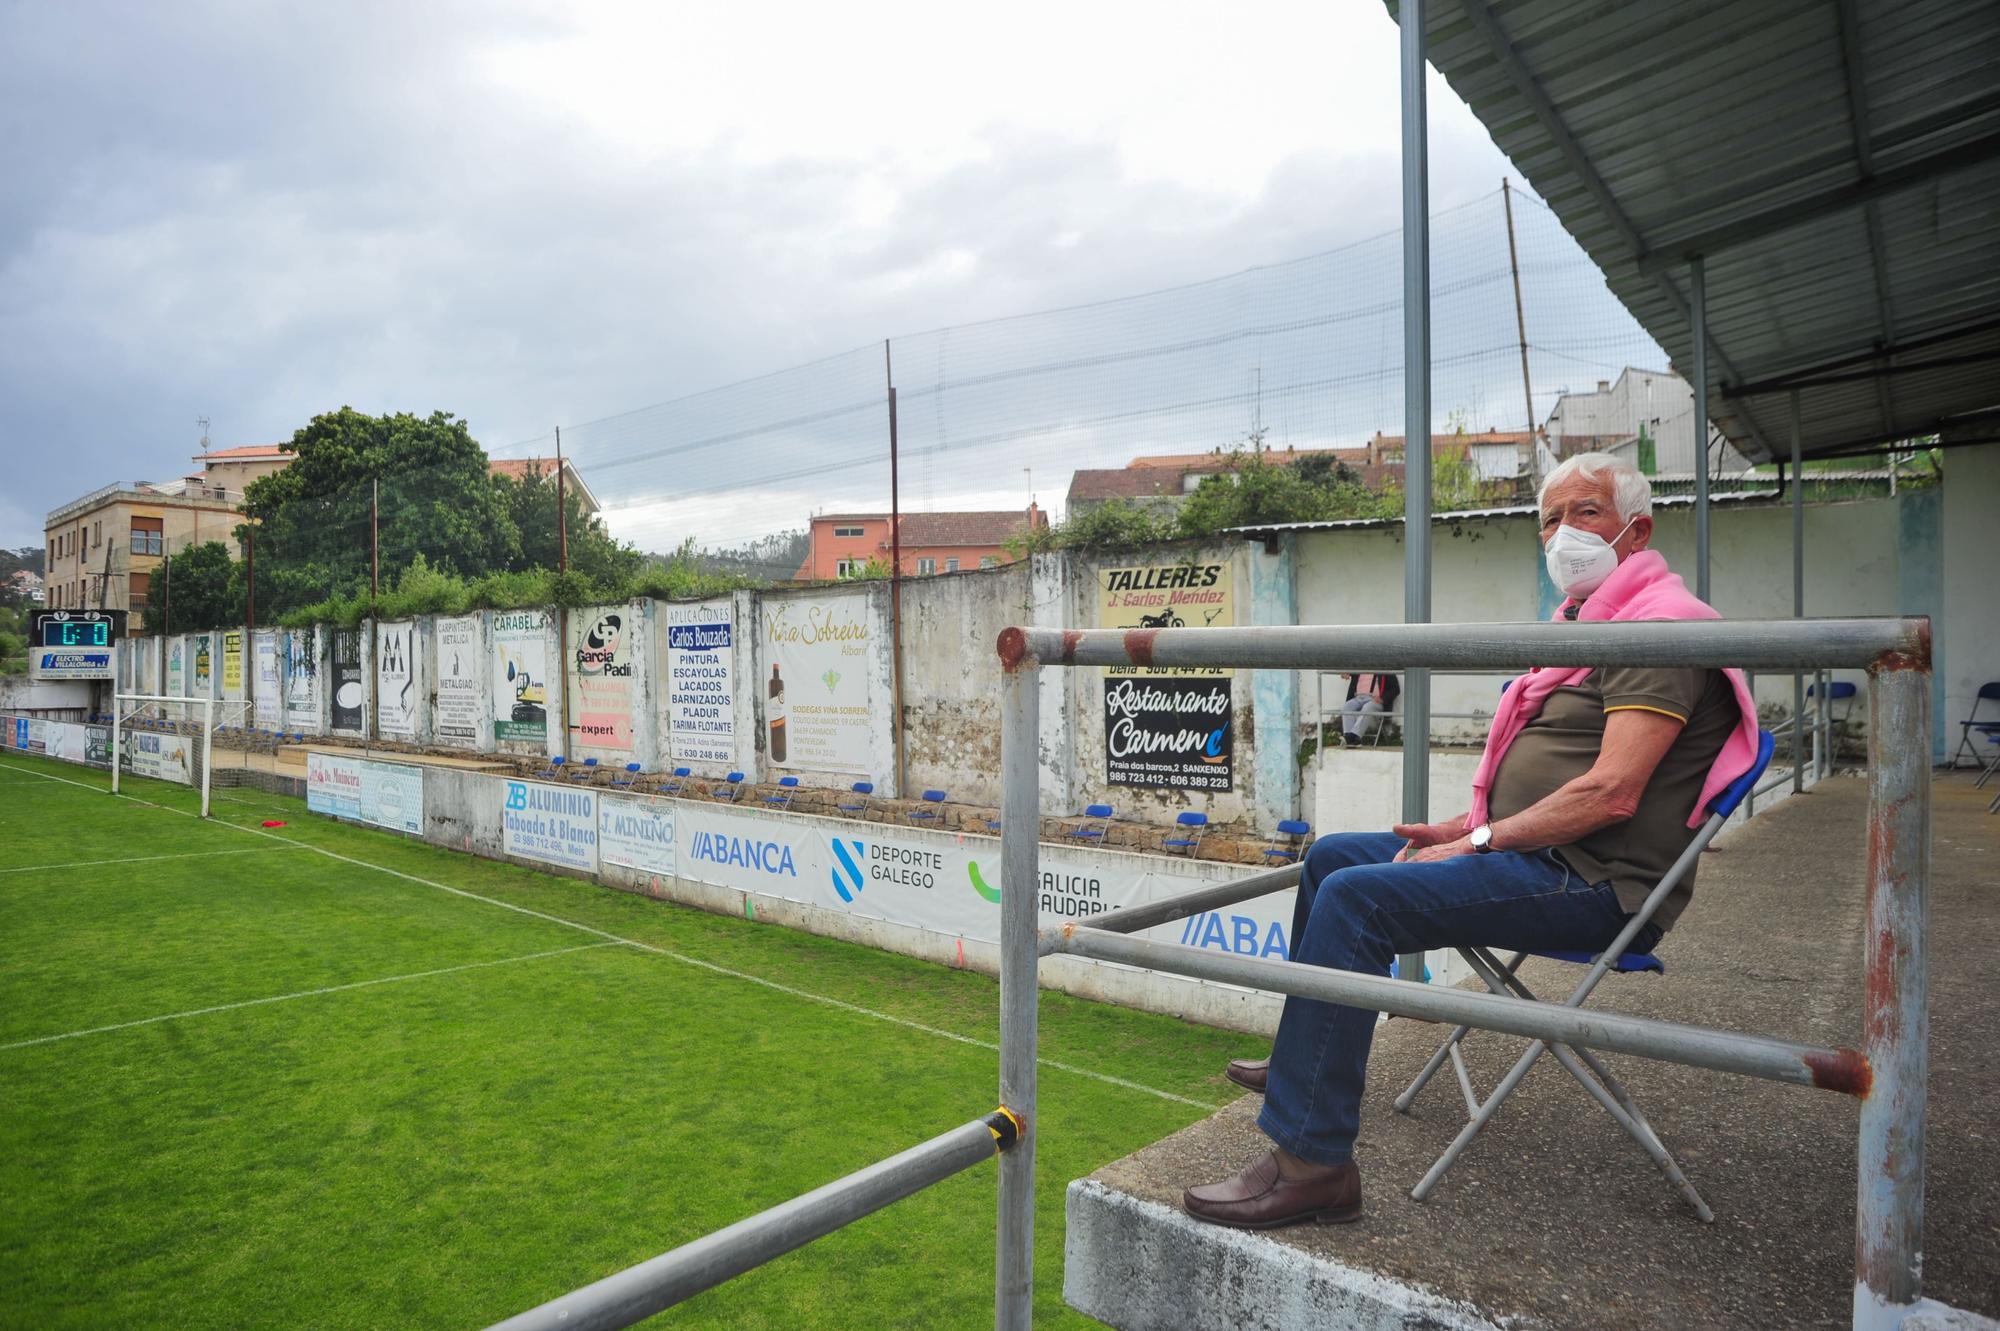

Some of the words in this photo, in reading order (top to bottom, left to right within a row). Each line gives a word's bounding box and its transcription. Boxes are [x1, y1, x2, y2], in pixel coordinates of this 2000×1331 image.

[1107, 565, 1221, 592] TALLERES
[1123, 591, 1165, 607] Carlos
[1169, 589, 1225, 606] Mendez
[670, 607, 729, 624] APLICACIONES
[671, 627, 694, 647] Carlos
[695, 625, 729, 647] Bouzada
[680, 654, 719, 665] PINTURA
[673, 667, 727, 678] ESCAYOLAS
[679, 681, 722, 692] LACADOS
[672, 694, 731, 705] BARNIZADOS
[1107, 679, 1229, 718] Restaurante
[683, 707, 719, 718] PLADUR
[792, 705, 821, 714] BODEGAS
[581, 725, 613, 736] expert
[673, 720, 697, 731] TARIMA
[698, 721, 732, 733] FLOTANTE
[1109, 717, 1208, 758] Carmen
[684, 749, 697, 758] 630
[700, 750, 713, 759] 248
[715, 751, 729, 760] 666
[1110, 760, 1129, 769] Praia
[1131, 761, 1145, 770] dos
[1182, 764, 1228, 775] SANXENXO
[1109, 772, 1126, 781] 986
[1128, 773, 1144, 782] 723
[1170, 775, 1188, 785] 606
[1190, 776, 1208, 786] 389
[1210, 778, 1229, 788] 228
[529, 788, 591, 818] ALUMINIO
[505, 811, 545, 836] Taboada
[549, 818, 556, 838] &
[559, 819, 595, 846] Blanco
[615, 814, 674, 844] MINIÑO
[568, 843, 585, 857] Meis
[871, 844, 942, 870] DEPORTE
[871, 864, 934, 889] GALEGO
[1037, 871, 1100, 898] ALICIA
